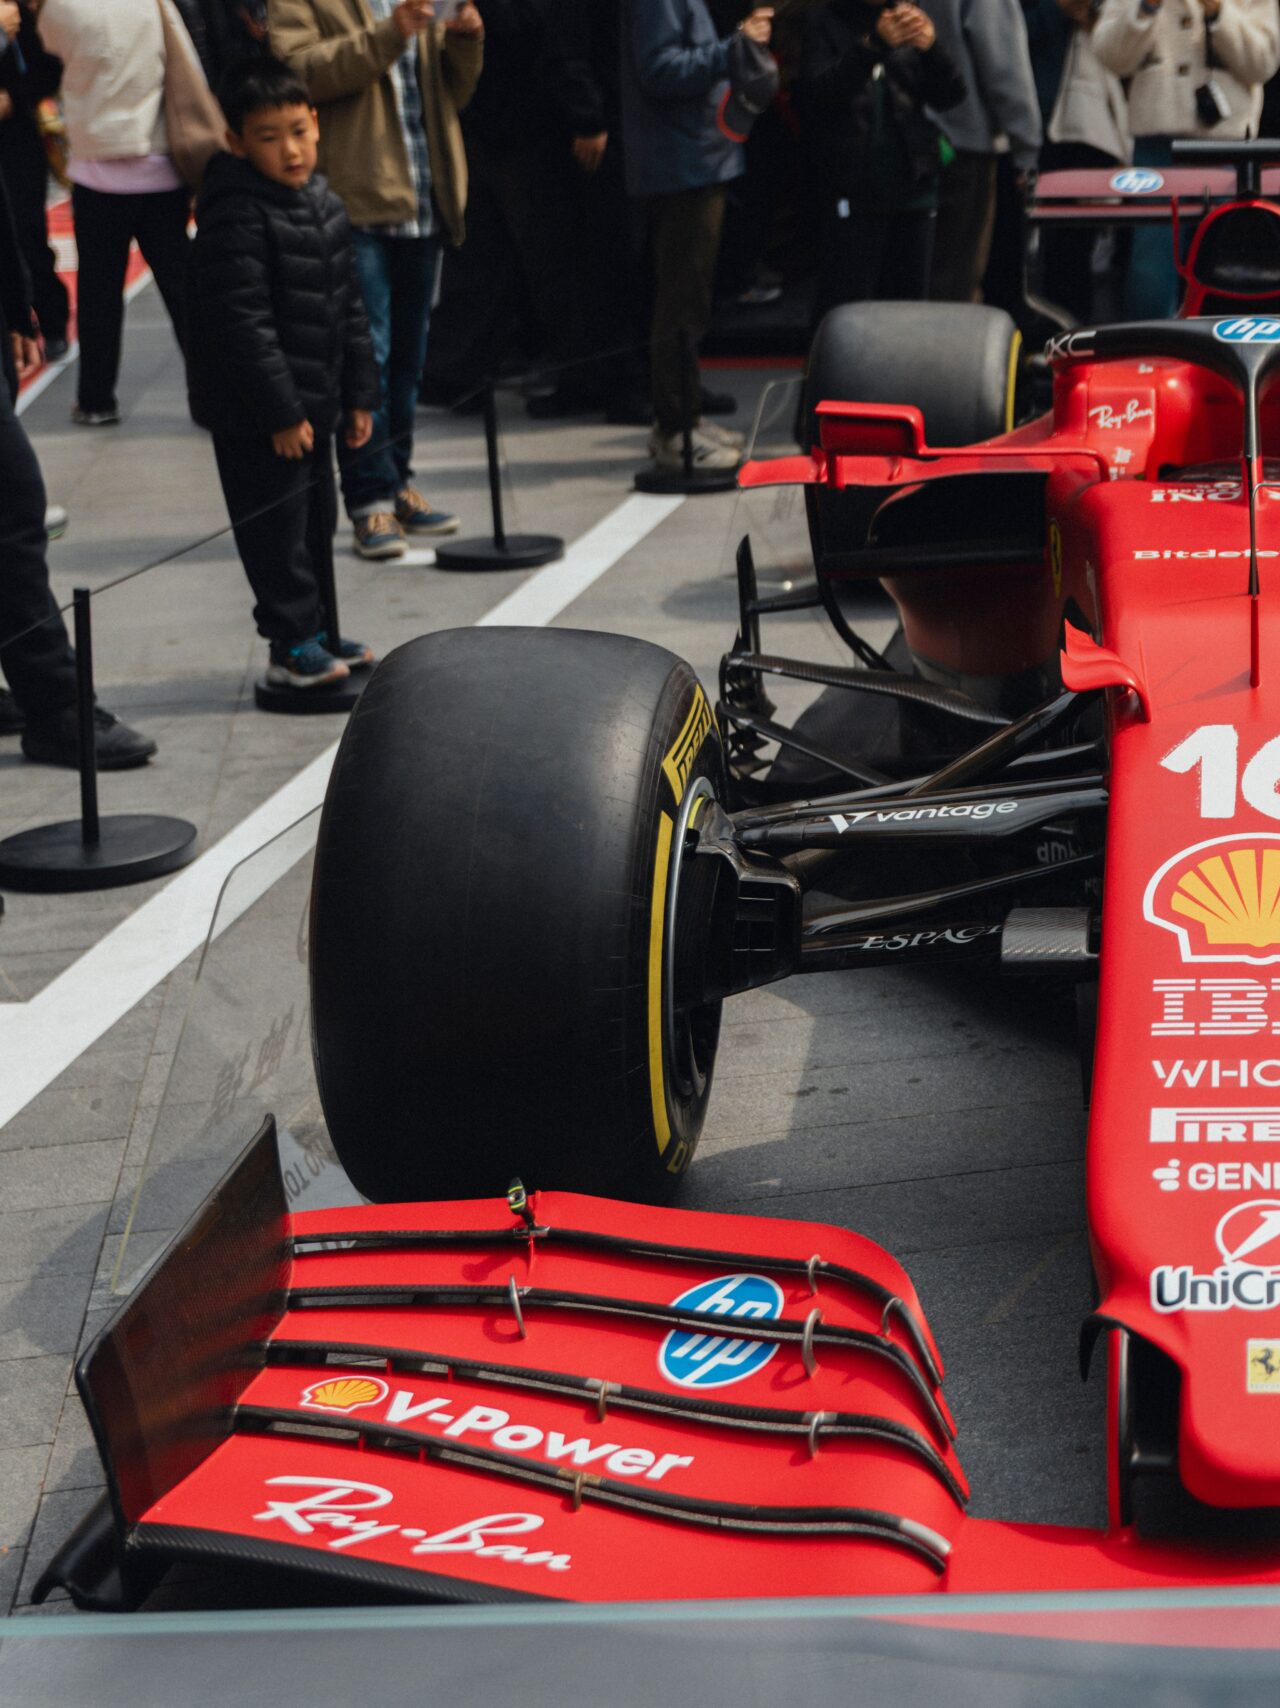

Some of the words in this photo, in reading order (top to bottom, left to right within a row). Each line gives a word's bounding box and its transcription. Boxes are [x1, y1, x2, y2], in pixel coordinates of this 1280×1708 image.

[1119, 168, 1157, 192] hp
[1222, 318, 1280, 342] hp
[876, 800, 1018, 823] vantage
[671, 1276, 773, 1385] hp
[384, 1389, 694, 1482] V-Power
[252, 1475, 572, 1572] Ray-Ban
